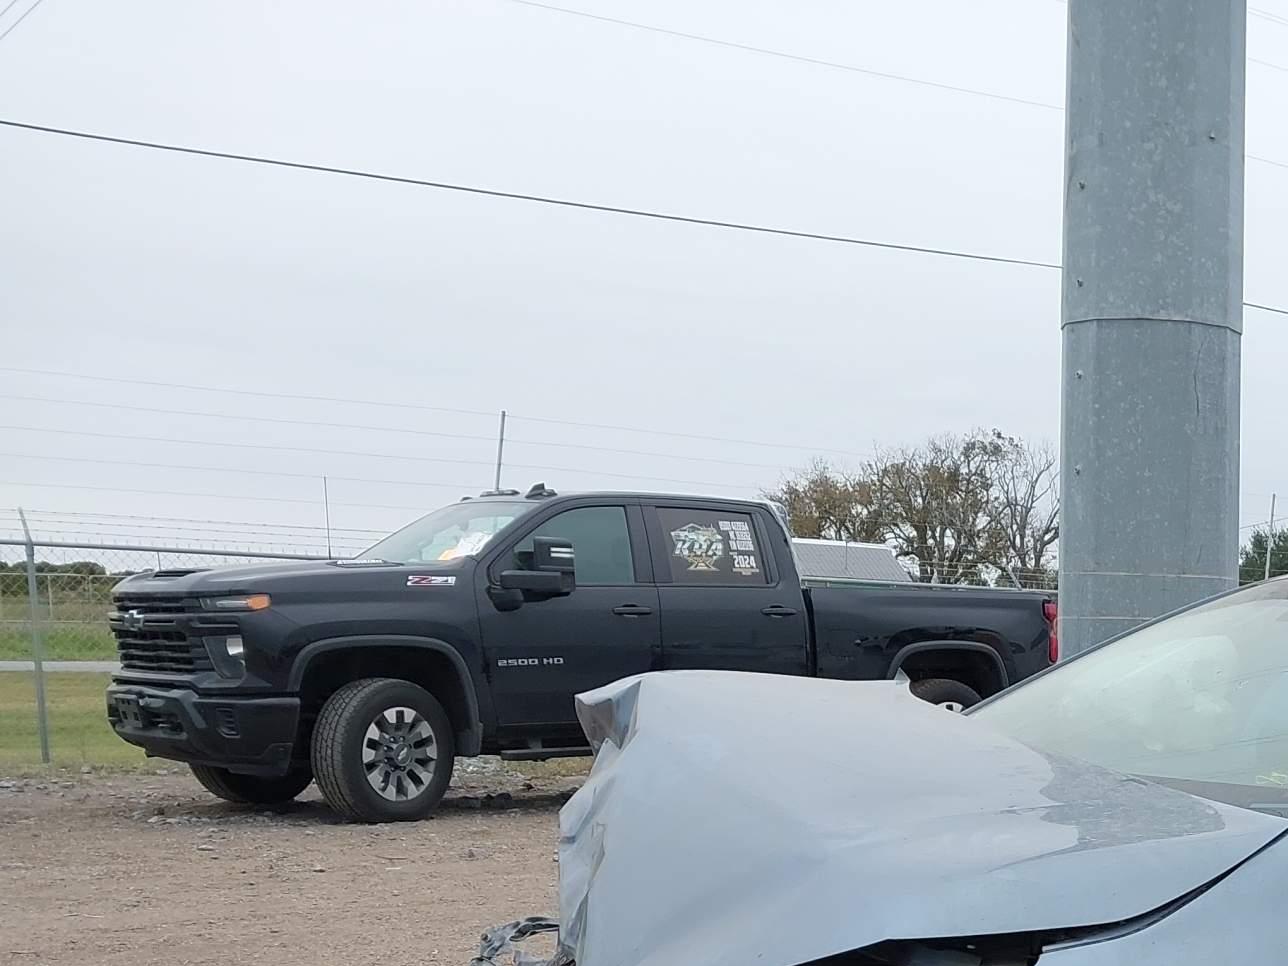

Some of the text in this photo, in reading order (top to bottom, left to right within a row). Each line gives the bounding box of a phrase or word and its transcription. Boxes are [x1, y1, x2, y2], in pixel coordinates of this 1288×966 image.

[733, 555, 757, 569] 2024
[497, 657, 564, 667] 2500 HD
